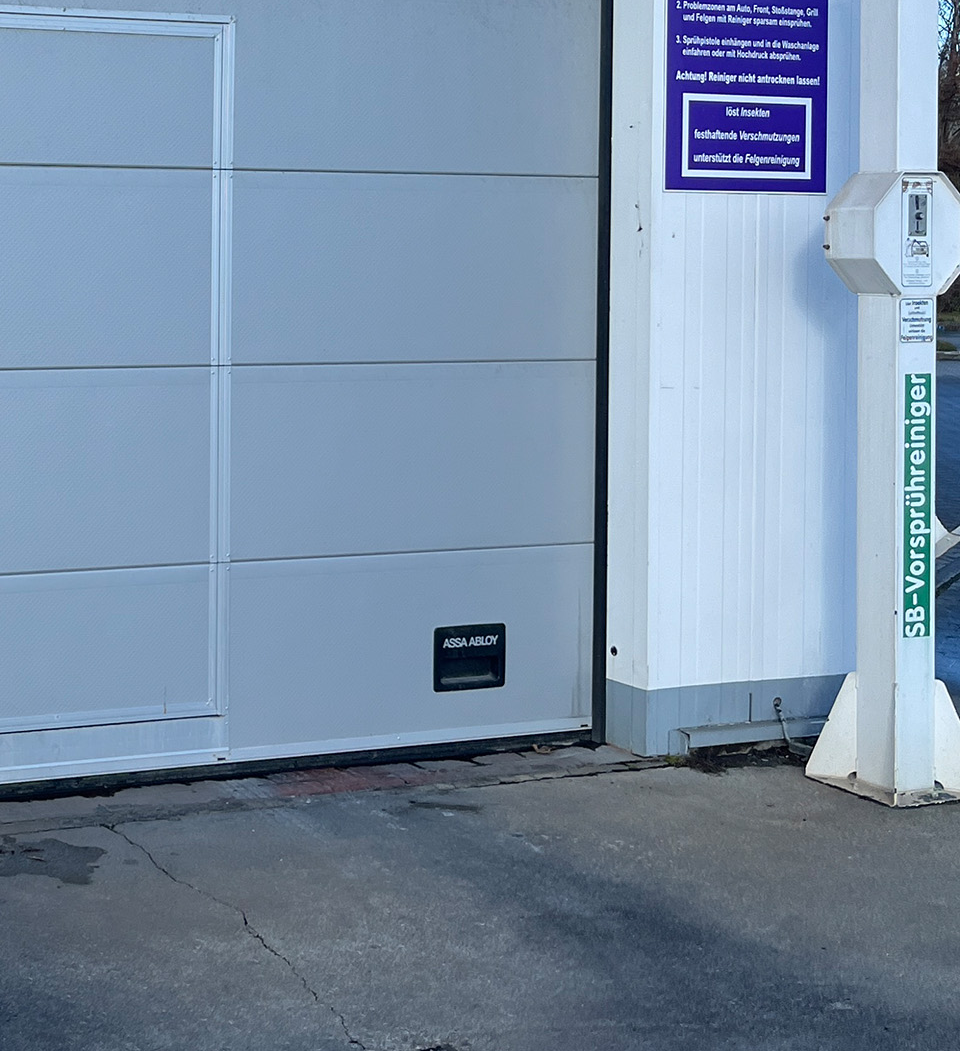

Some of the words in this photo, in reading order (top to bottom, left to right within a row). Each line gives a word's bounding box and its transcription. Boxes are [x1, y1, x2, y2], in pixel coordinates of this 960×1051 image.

[675, 0, 682, 9] 2.
[682, 0, 726, 12] Problemzonen
[726, 4, 736, 12] am
[736, 4, 753, 14] Auto,
[753, 4, 771, 15] Front,
[771, 6, 806, 18] Stoßstange,
[806, 7, 819, 17] Grill
[682, 13, 695, 22] und
[695, 13, 716, 25] Felgen
[716, 14, 727, 24] mit
[727, 15, 753, 27] Reiniger
[753, 17, 778, 28] sparsam
[778, 18, 813, 28] einsprühen.
[675, 34, 682, 44] 3.
[682, 35, 721, 46] Sprühpistole
[721, 37, 752, 49] einhängen
[752, 39, 765, 48] und
[765, 39, 771, 48] in
[771, 40, 781, 49] die
[781, 40, 820, 52] Waschanlage
[682, 47, 711, 57] einfahren
[711, 49, 726, 58] oder
[726, 49, 736, 59] mit
[736, 50, 769, 60] Hochdruck
[769, 52, 802, 62] absprühen.
[675, 70, 708, 85] Achtung!
[708, 71, 737, 85] Reiniger
[737, 73, 756, 84] nicht
[756, 74, 796, 86] antrocknen
[796, 75, 821, 86] lassen!
[725, 106, 740, 117] löst
[740, 106, 771, 118] Insekten
[693, 129, 738, 140] festhaftende
[738, 130, 801, 145] Verschmutzungen
[693, 152, 732, 164] unterstützt
[732, 153, 744, 164] die
[744, 154, 801, 168] Felgenreinigung
[904, 373, 931, 638] SB-Vorsprühreiniger
[443, 637, 468, 649] ASSA
[469, 635, 499, 648] ABLOY
